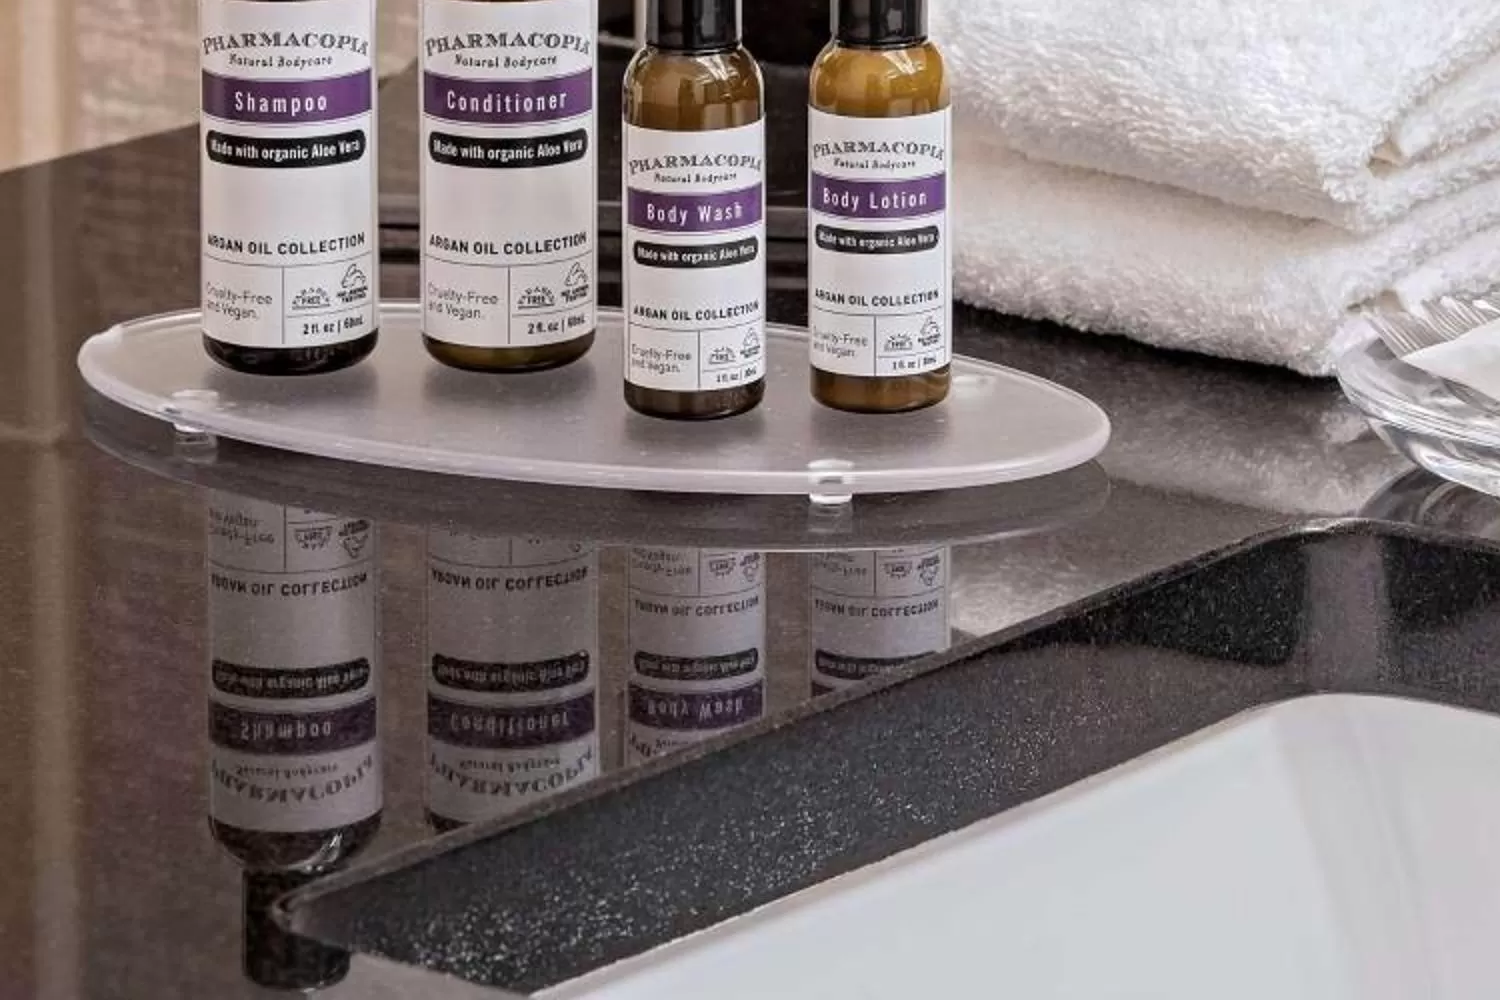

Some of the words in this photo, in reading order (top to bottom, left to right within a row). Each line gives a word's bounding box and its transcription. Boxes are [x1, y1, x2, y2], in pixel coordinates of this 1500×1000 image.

[202, 32, 369, 56] PHARMACOPIA
[425, 32, 591, 56] PHARMACOPIA
[228, 53, 274, 68] Natural
[277, 54, 334, 71] Bodycare
[454, 53, 499, 69] Natural
[503, 55, 558, 71] Bodycare
[234, 91, 328, 116] Shampoo
[446, 89, 568, 114] Conditioner
[235, 144, 259, 160] with
[261, 145, 309, 163] organic
[311, 142, 337, 158] Aloe
[433, 138, 457, 157] Made
[459, 145, 485, 160] with
[487, 145, 535, 163] organic
[537, 142, 561, 158] Aloe
[813, 140, 945, 161] PHARMACOPIA
[628, 153, 762, 176] PHARMACOPIA
[823, 186, 860, 212] Body
[868, 190, 928, 209] Lotion
[646, 202, 689, 227] Body
[698, 200, 744, 224] Wash
[247, 241, 273, 256] OIL
[277, 231, 366, 256] COLLECTION
[429, 233, 469, 254] ARGAN
[473, 241, 499, 256] OIL
[503, 231, 588, 256] COLLECTION
[848, 294, 869, 307] OIL
[871, 288, 939, 307] COLLECTION
[671, 309, 692, 322] OIL
[695, 299, 760, 321] COLLECTION
[303, 322, 309, 336] 2
[527, 322, 535, 335] 2
